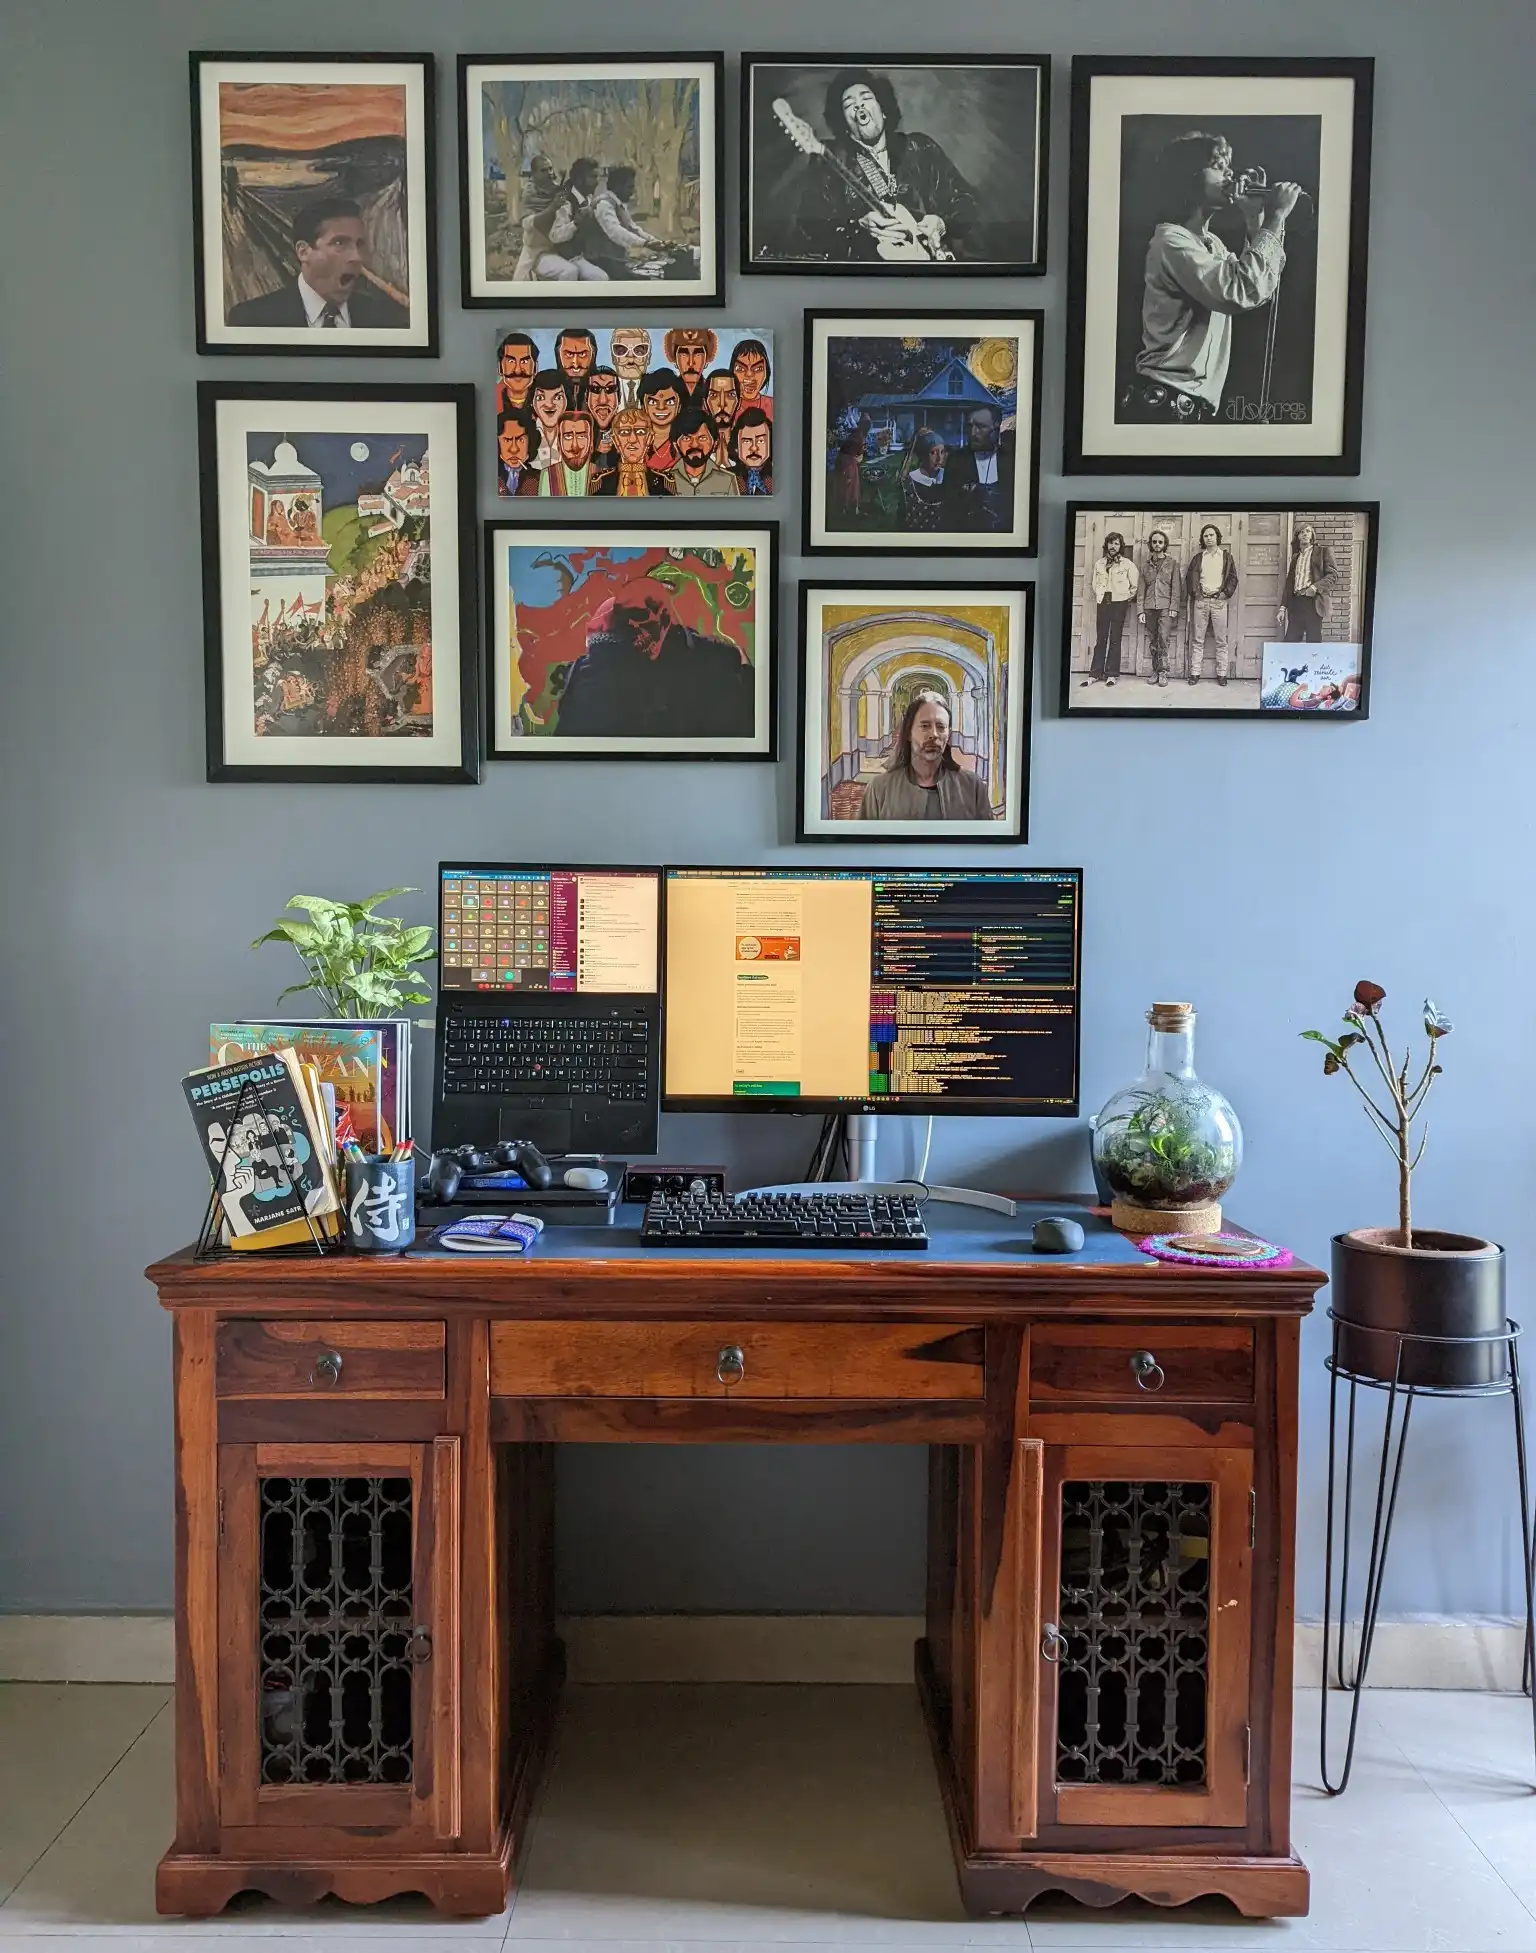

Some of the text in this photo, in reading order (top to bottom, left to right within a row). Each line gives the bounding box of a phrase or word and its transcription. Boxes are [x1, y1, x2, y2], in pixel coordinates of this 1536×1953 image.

[247, 1043, 267, 1051] THE
[190, 1063, 285, 1100] PERSEPOLIS
[254, 1205, 302, 1224] MARJANE SATR
[350, 1171, 408, 1242] 侍
